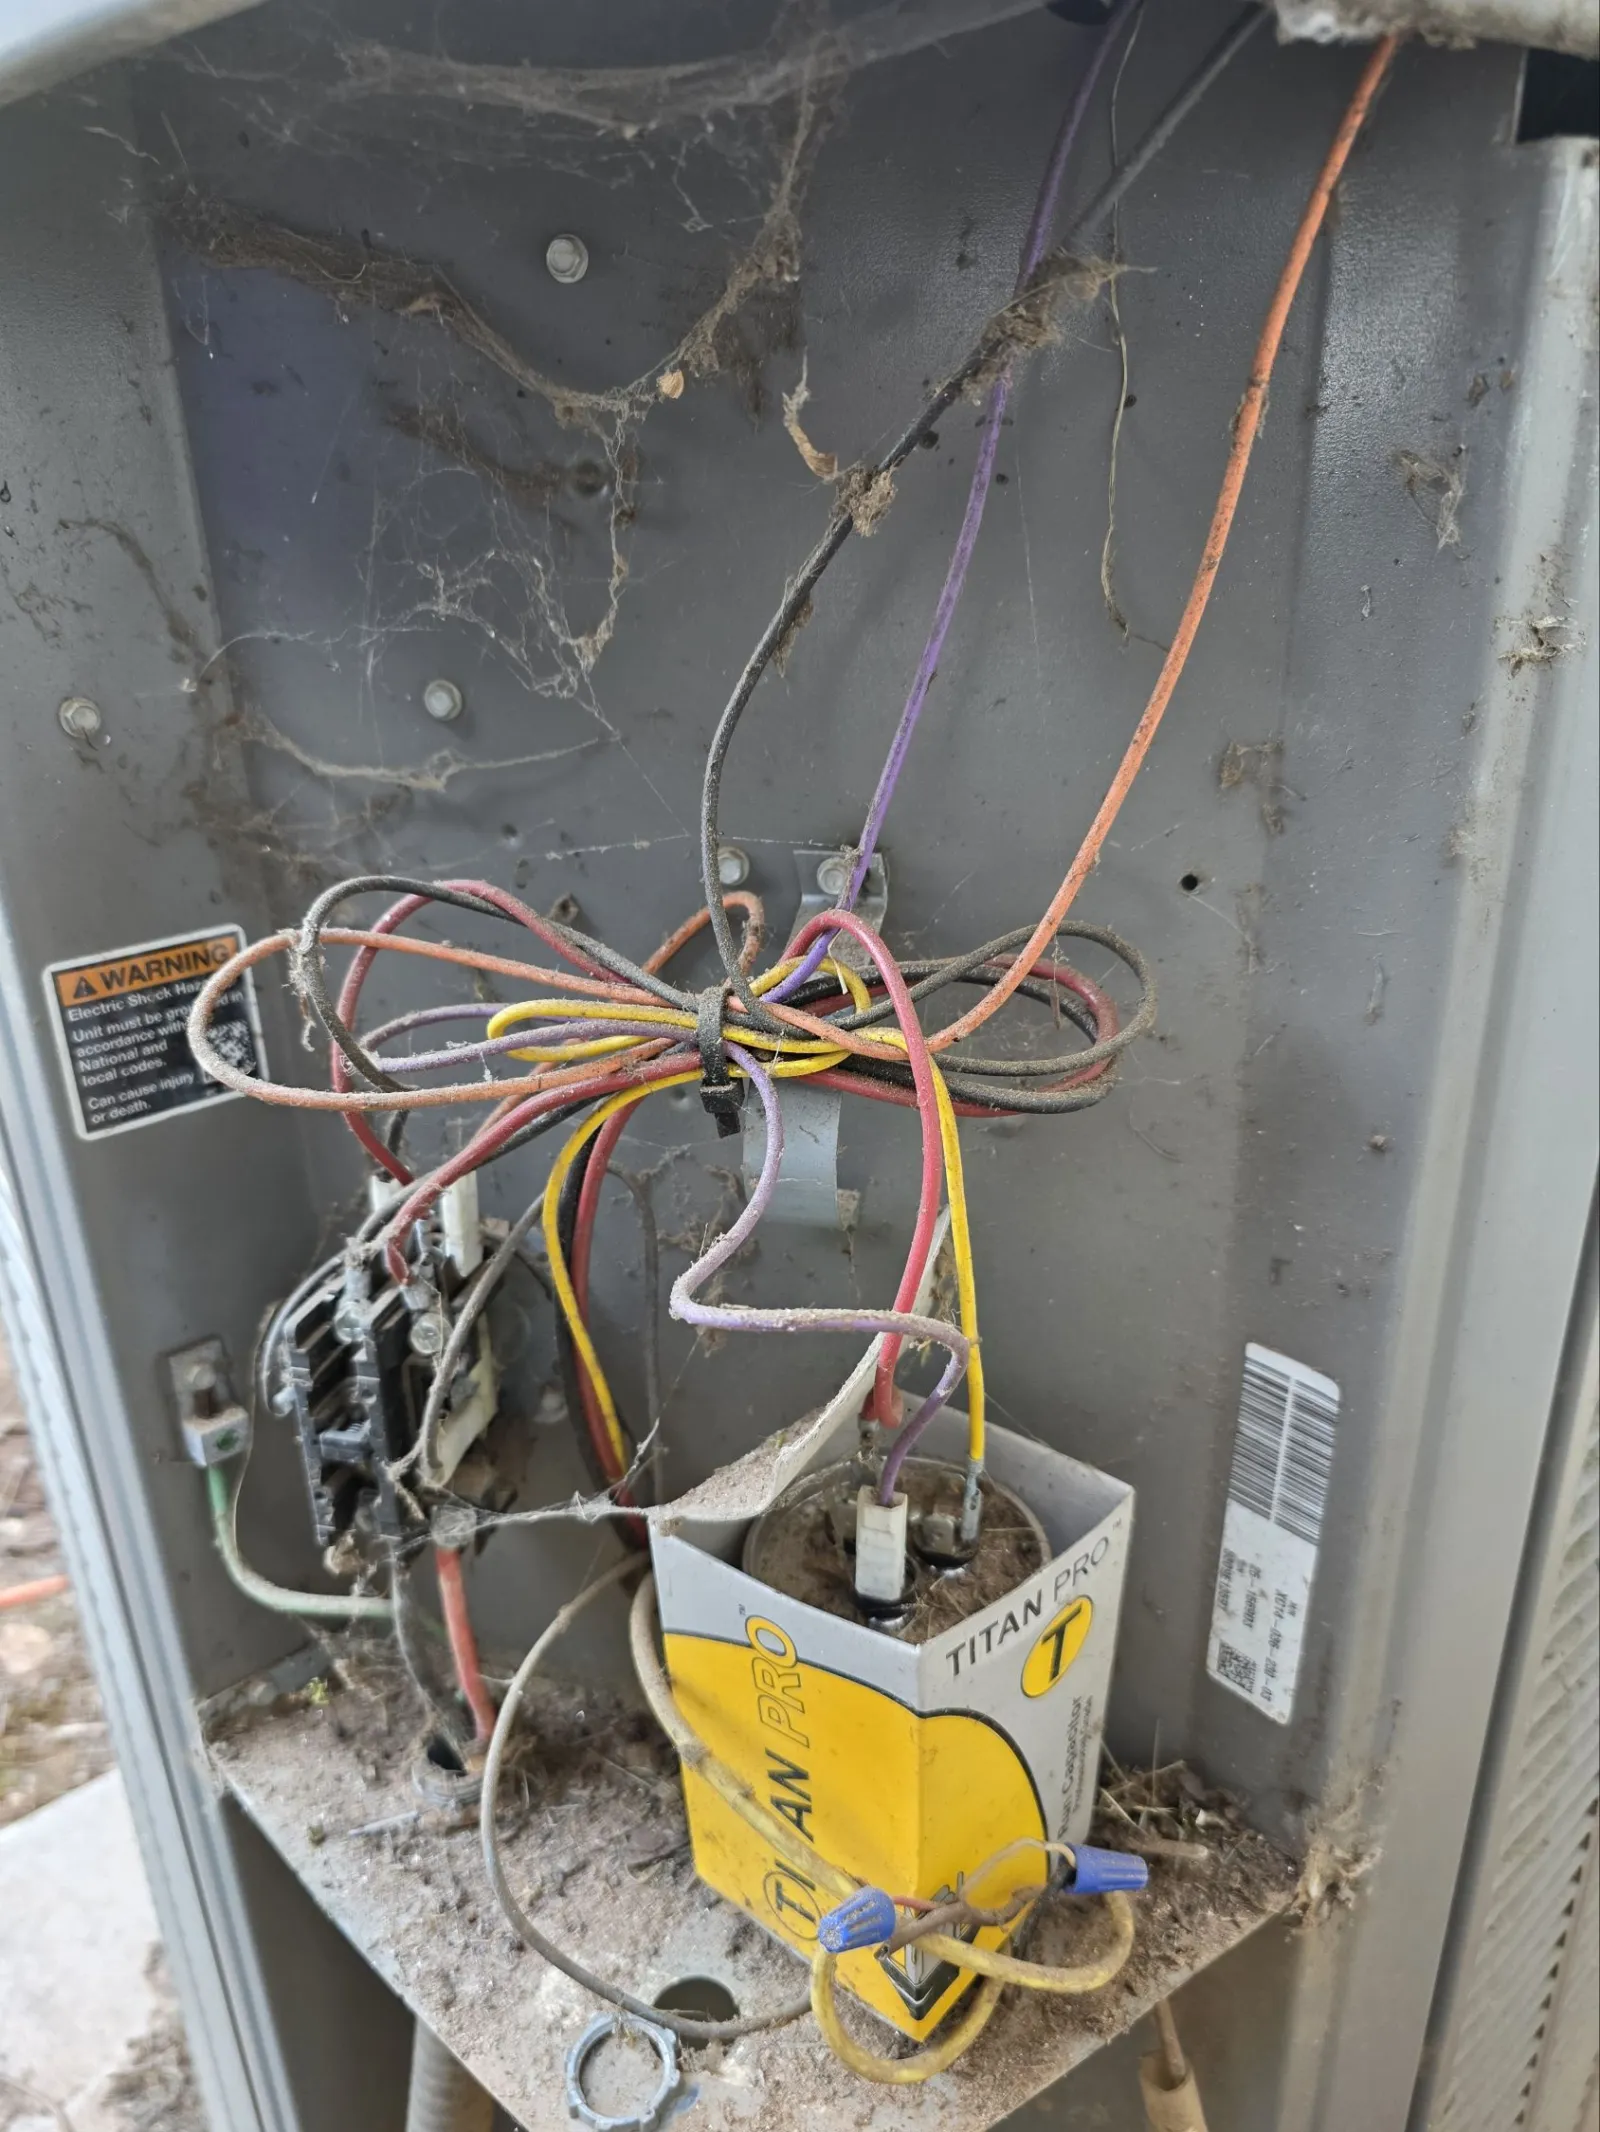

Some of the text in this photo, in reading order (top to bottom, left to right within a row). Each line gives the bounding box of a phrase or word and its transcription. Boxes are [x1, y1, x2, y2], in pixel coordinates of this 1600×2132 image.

[101, 944, 230, 990] WARNING
[67, 980, 206, 1022] Electric Shock Haz
[72, 1025, 103, 1043] Unit
[106, 1018, 143, 1035] must
[145, 1011, 163, 1026] be
[77, 1019, 188, 1058] accordance with
[78, 1040, 169, 1073] National and
[81, 1057, 168, 1087] local codes.
[88, 1072, 196, 1110] Can cause injury
[91, 1100, 152, 1124] or death.
[946, 1589, 1043, 1676] TITAN
[1053, 1536, 1110, 1603] PRO
[744, 1614, 811, 1749] PRO
[1057, 1696, 1082, 1840] Run Capacitor
[764, 1749, 817, 1925] TIAN
